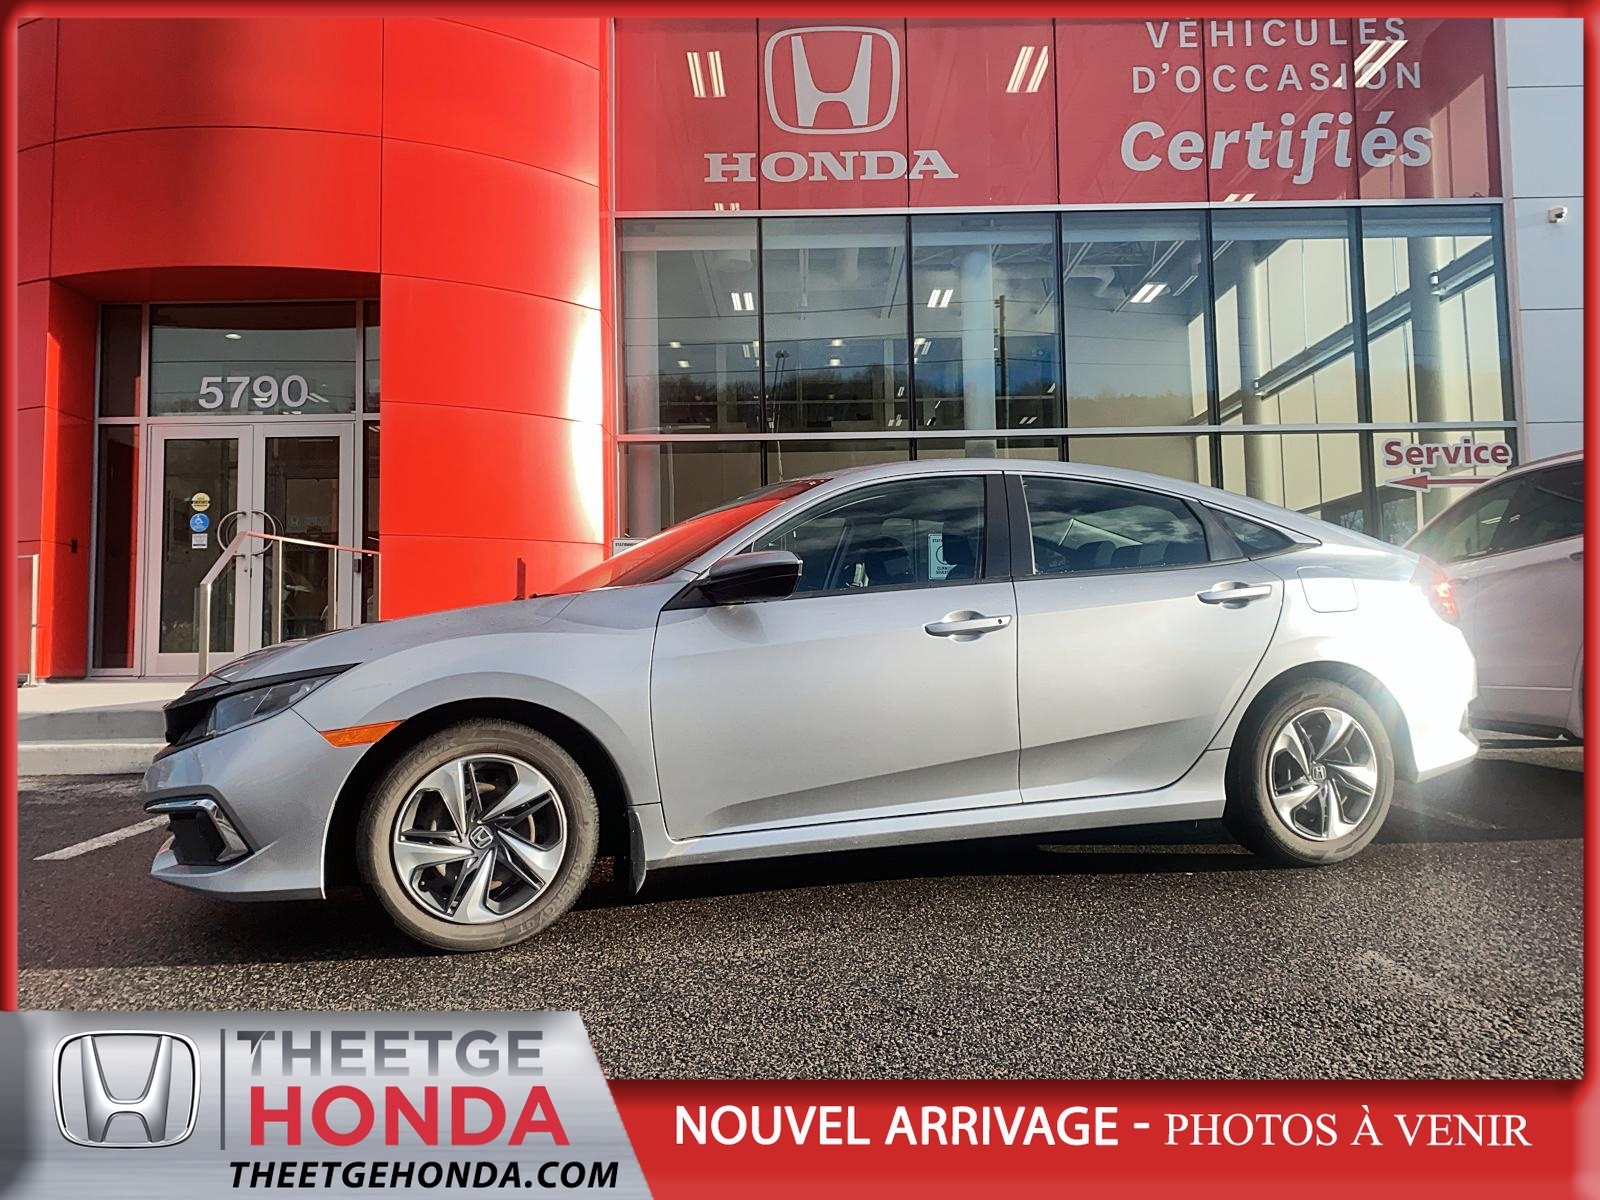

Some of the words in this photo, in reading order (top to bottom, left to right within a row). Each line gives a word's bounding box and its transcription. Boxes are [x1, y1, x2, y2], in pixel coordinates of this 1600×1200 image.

[1120, 111, 1434, 185] Certifiés
[704, 149, 959, 183] HONDA
[198, 374, 309, 409] 5790
[1384, 438, 1510, 466] Service
